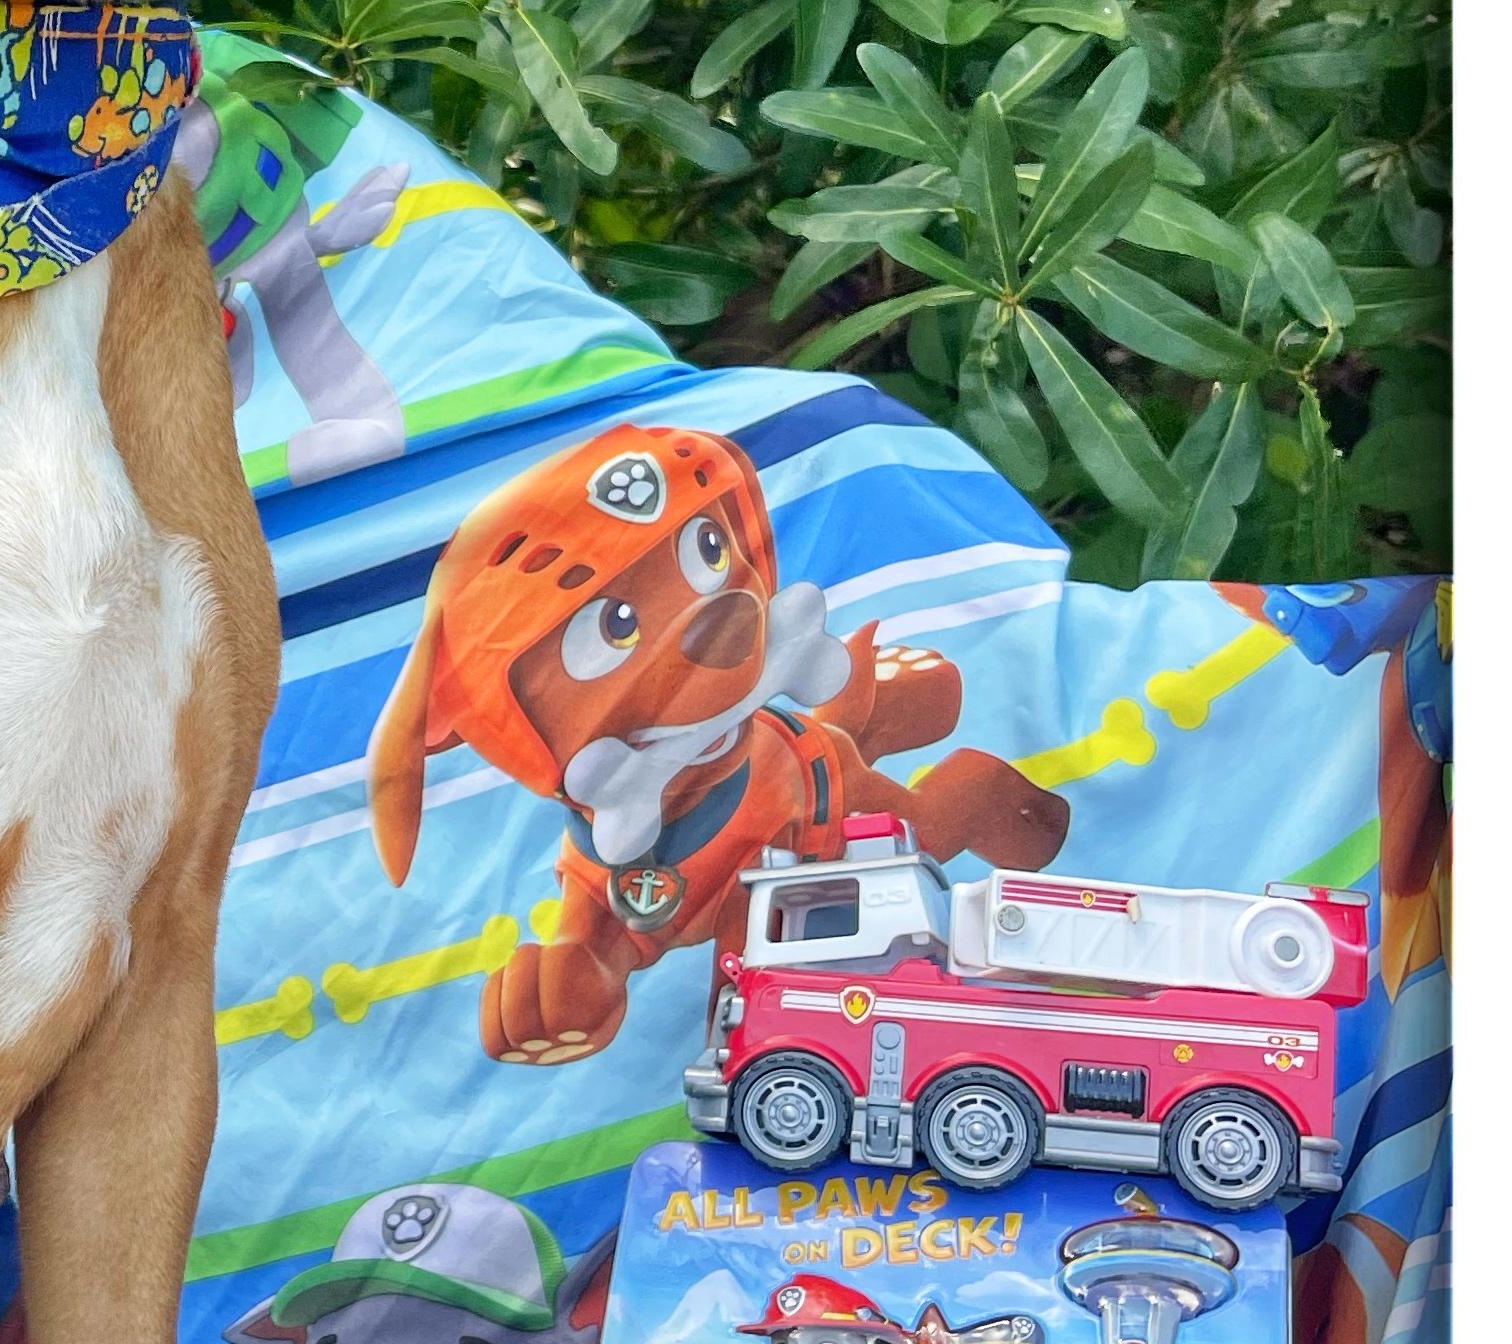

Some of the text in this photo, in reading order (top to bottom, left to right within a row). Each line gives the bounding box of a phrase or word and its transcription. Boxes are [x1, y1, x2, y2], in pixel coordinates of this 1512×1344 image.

[1267, 1035, 1301, 1048] 03
[657, 1170, 950, 1232] ALL PAWS
[782, 1212, 1024, 1269] ON DECK!
